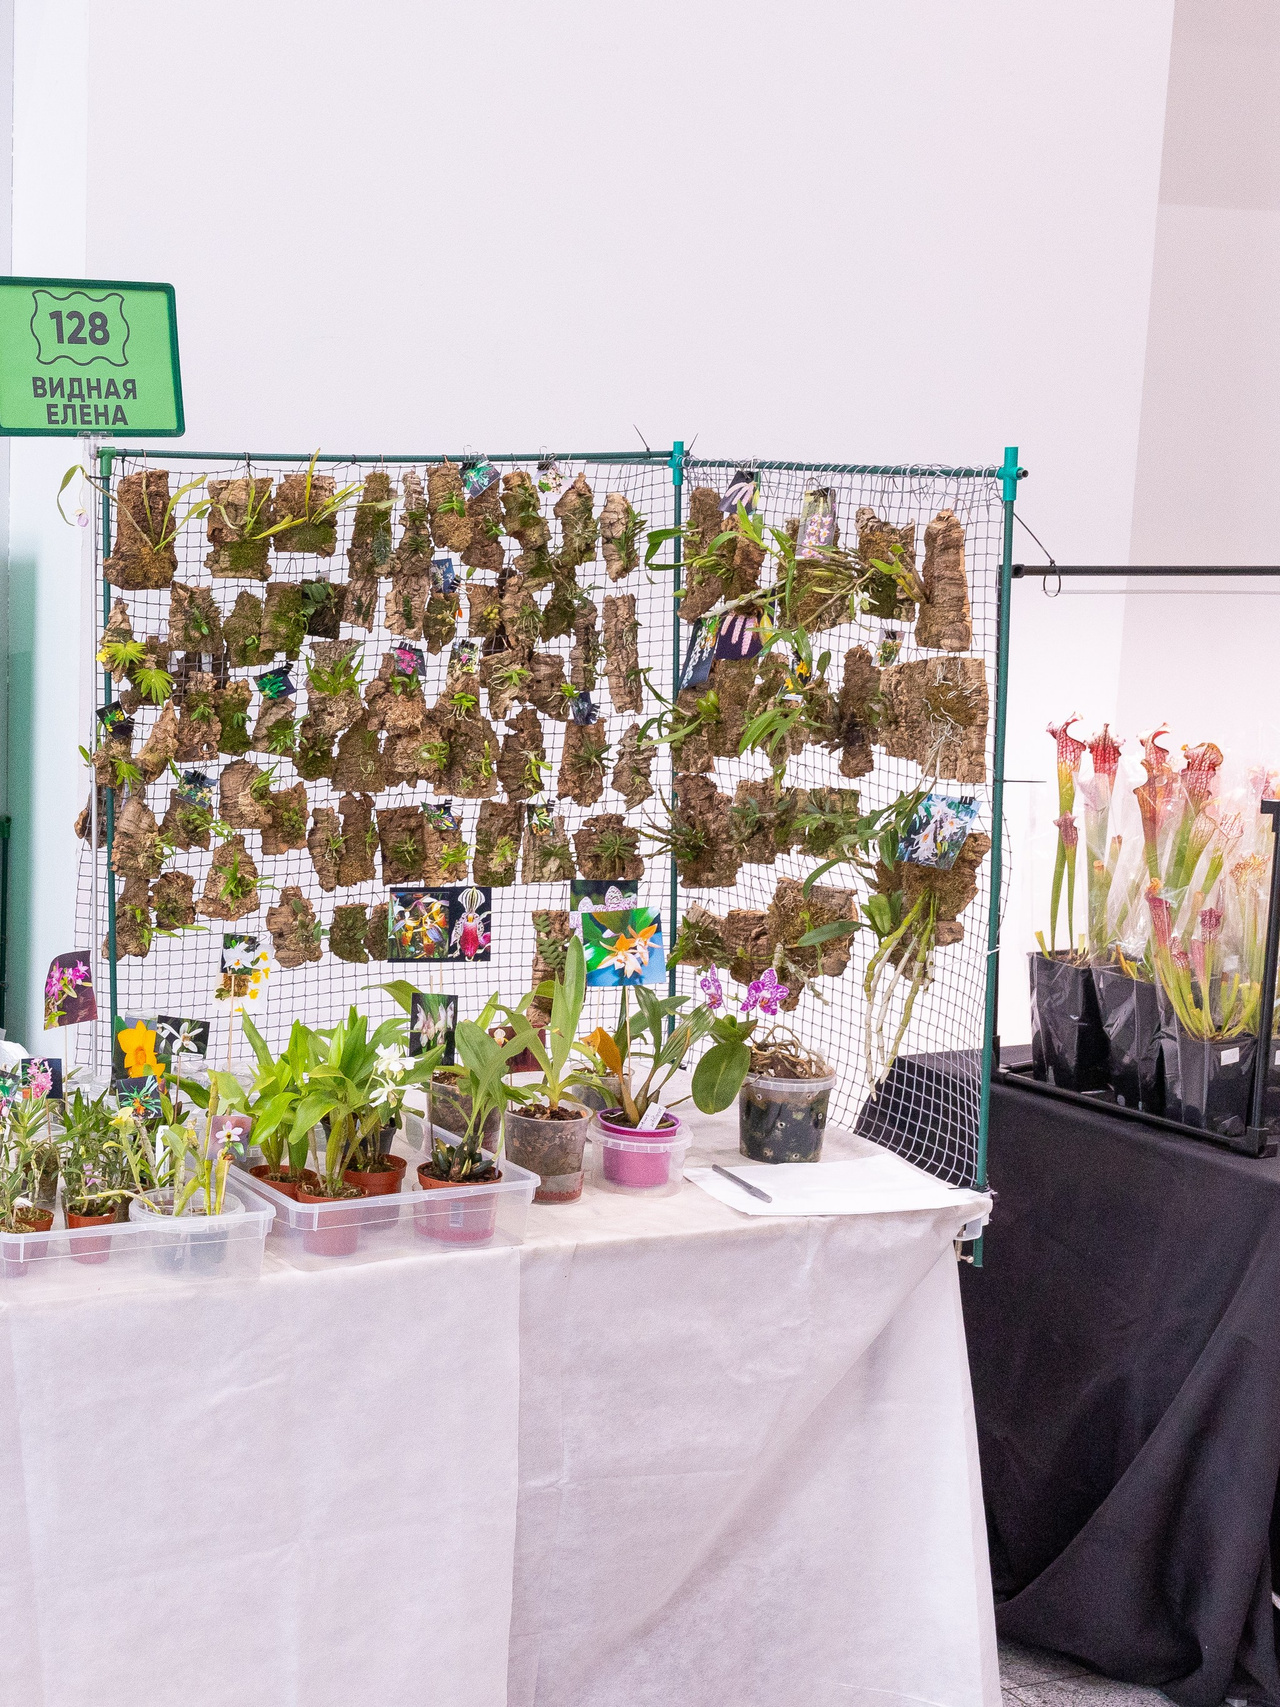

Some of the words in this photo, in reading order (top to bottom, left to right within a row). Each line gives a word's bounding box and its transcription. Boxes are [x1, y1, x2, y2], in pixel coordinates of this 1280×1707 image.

[48, 310, 110, 346] 128
[32, 376, 137, 403] ВИДНАЯ
[46, 403, 129, 425] ЕЛЕНА
